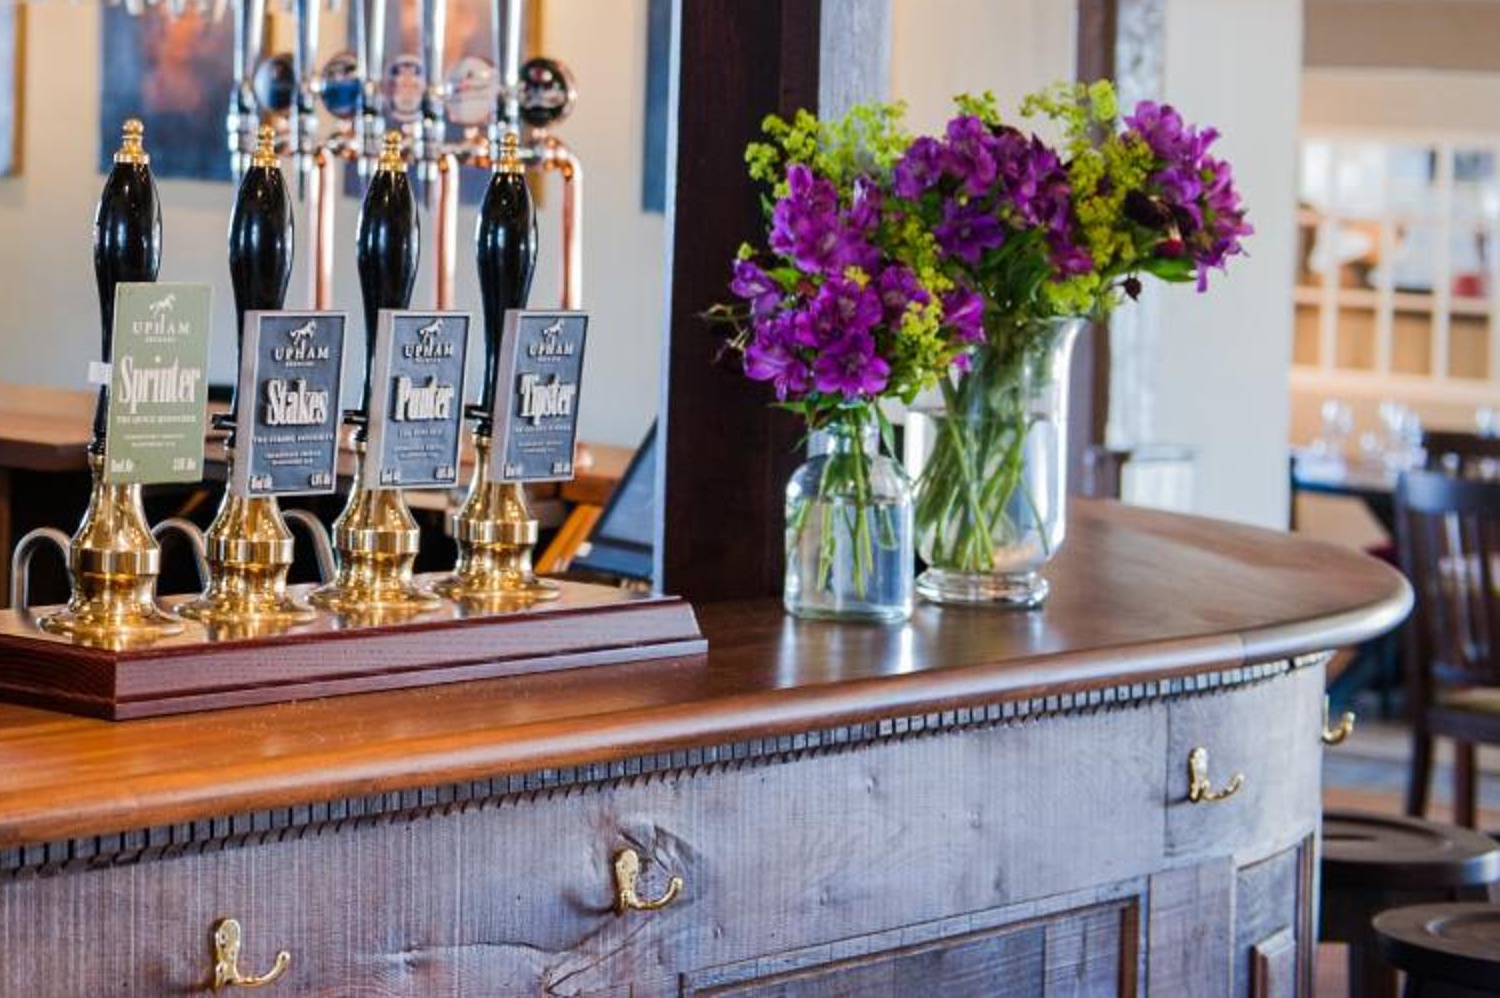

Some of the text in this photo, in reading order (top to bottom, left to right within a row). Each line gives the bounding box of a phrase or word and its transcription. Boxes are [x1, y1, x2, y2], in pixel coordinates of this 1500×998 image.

[132, 314, 190, 336] UPHAM
[274, 339, 330, 361] UPHAM
[404, 338, 453, 358] UPHAM
[118, 355, 201, 414] Sprinter
[265, 377, 328, 426] Stakes
[520, 373, 577, 426] Tipster
